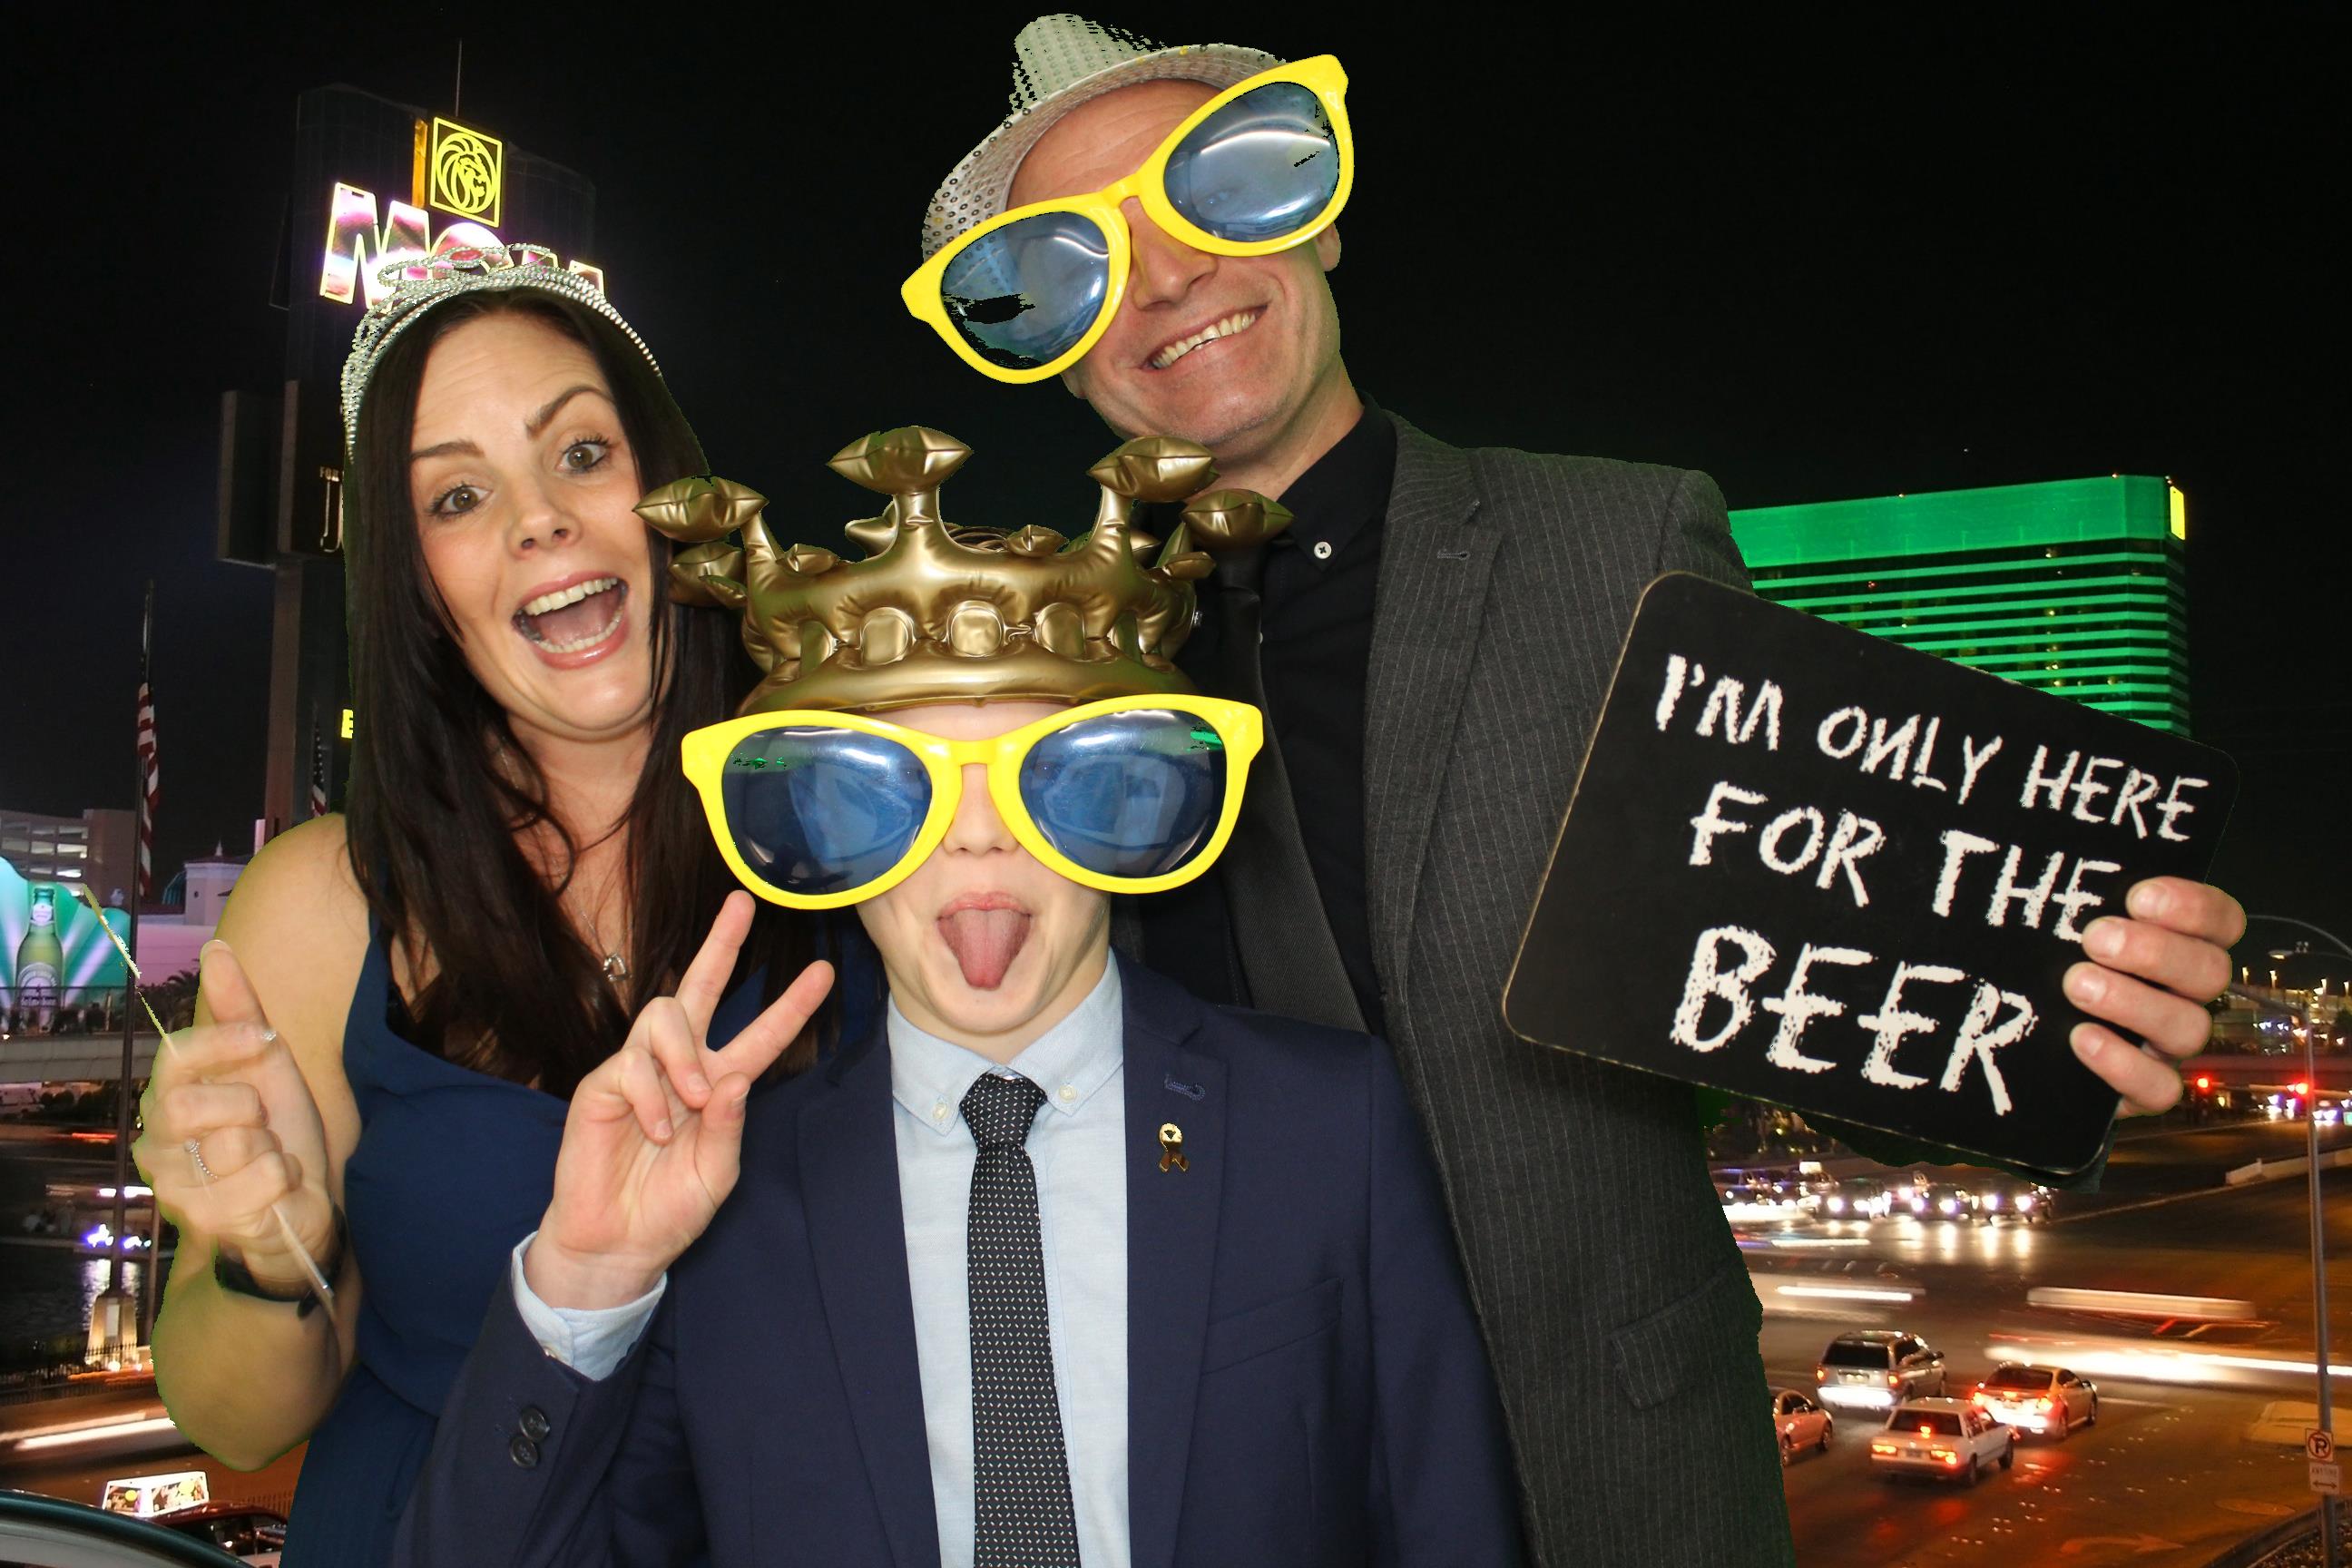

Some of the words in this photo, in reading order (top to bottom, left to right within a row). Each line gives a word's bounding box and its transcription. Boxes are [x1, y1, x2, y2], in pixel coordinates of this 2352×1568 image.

[1655, 653, 1783, 751] I'M
[1817, 705, 2003, 805] ONLY
[2020, 744, 2209, 842] HERE
[1689, 780, 1886, 907] FOR
[1932, 829, 2122, 944] THE
[1670, 924, 2040, 1116] BEER
